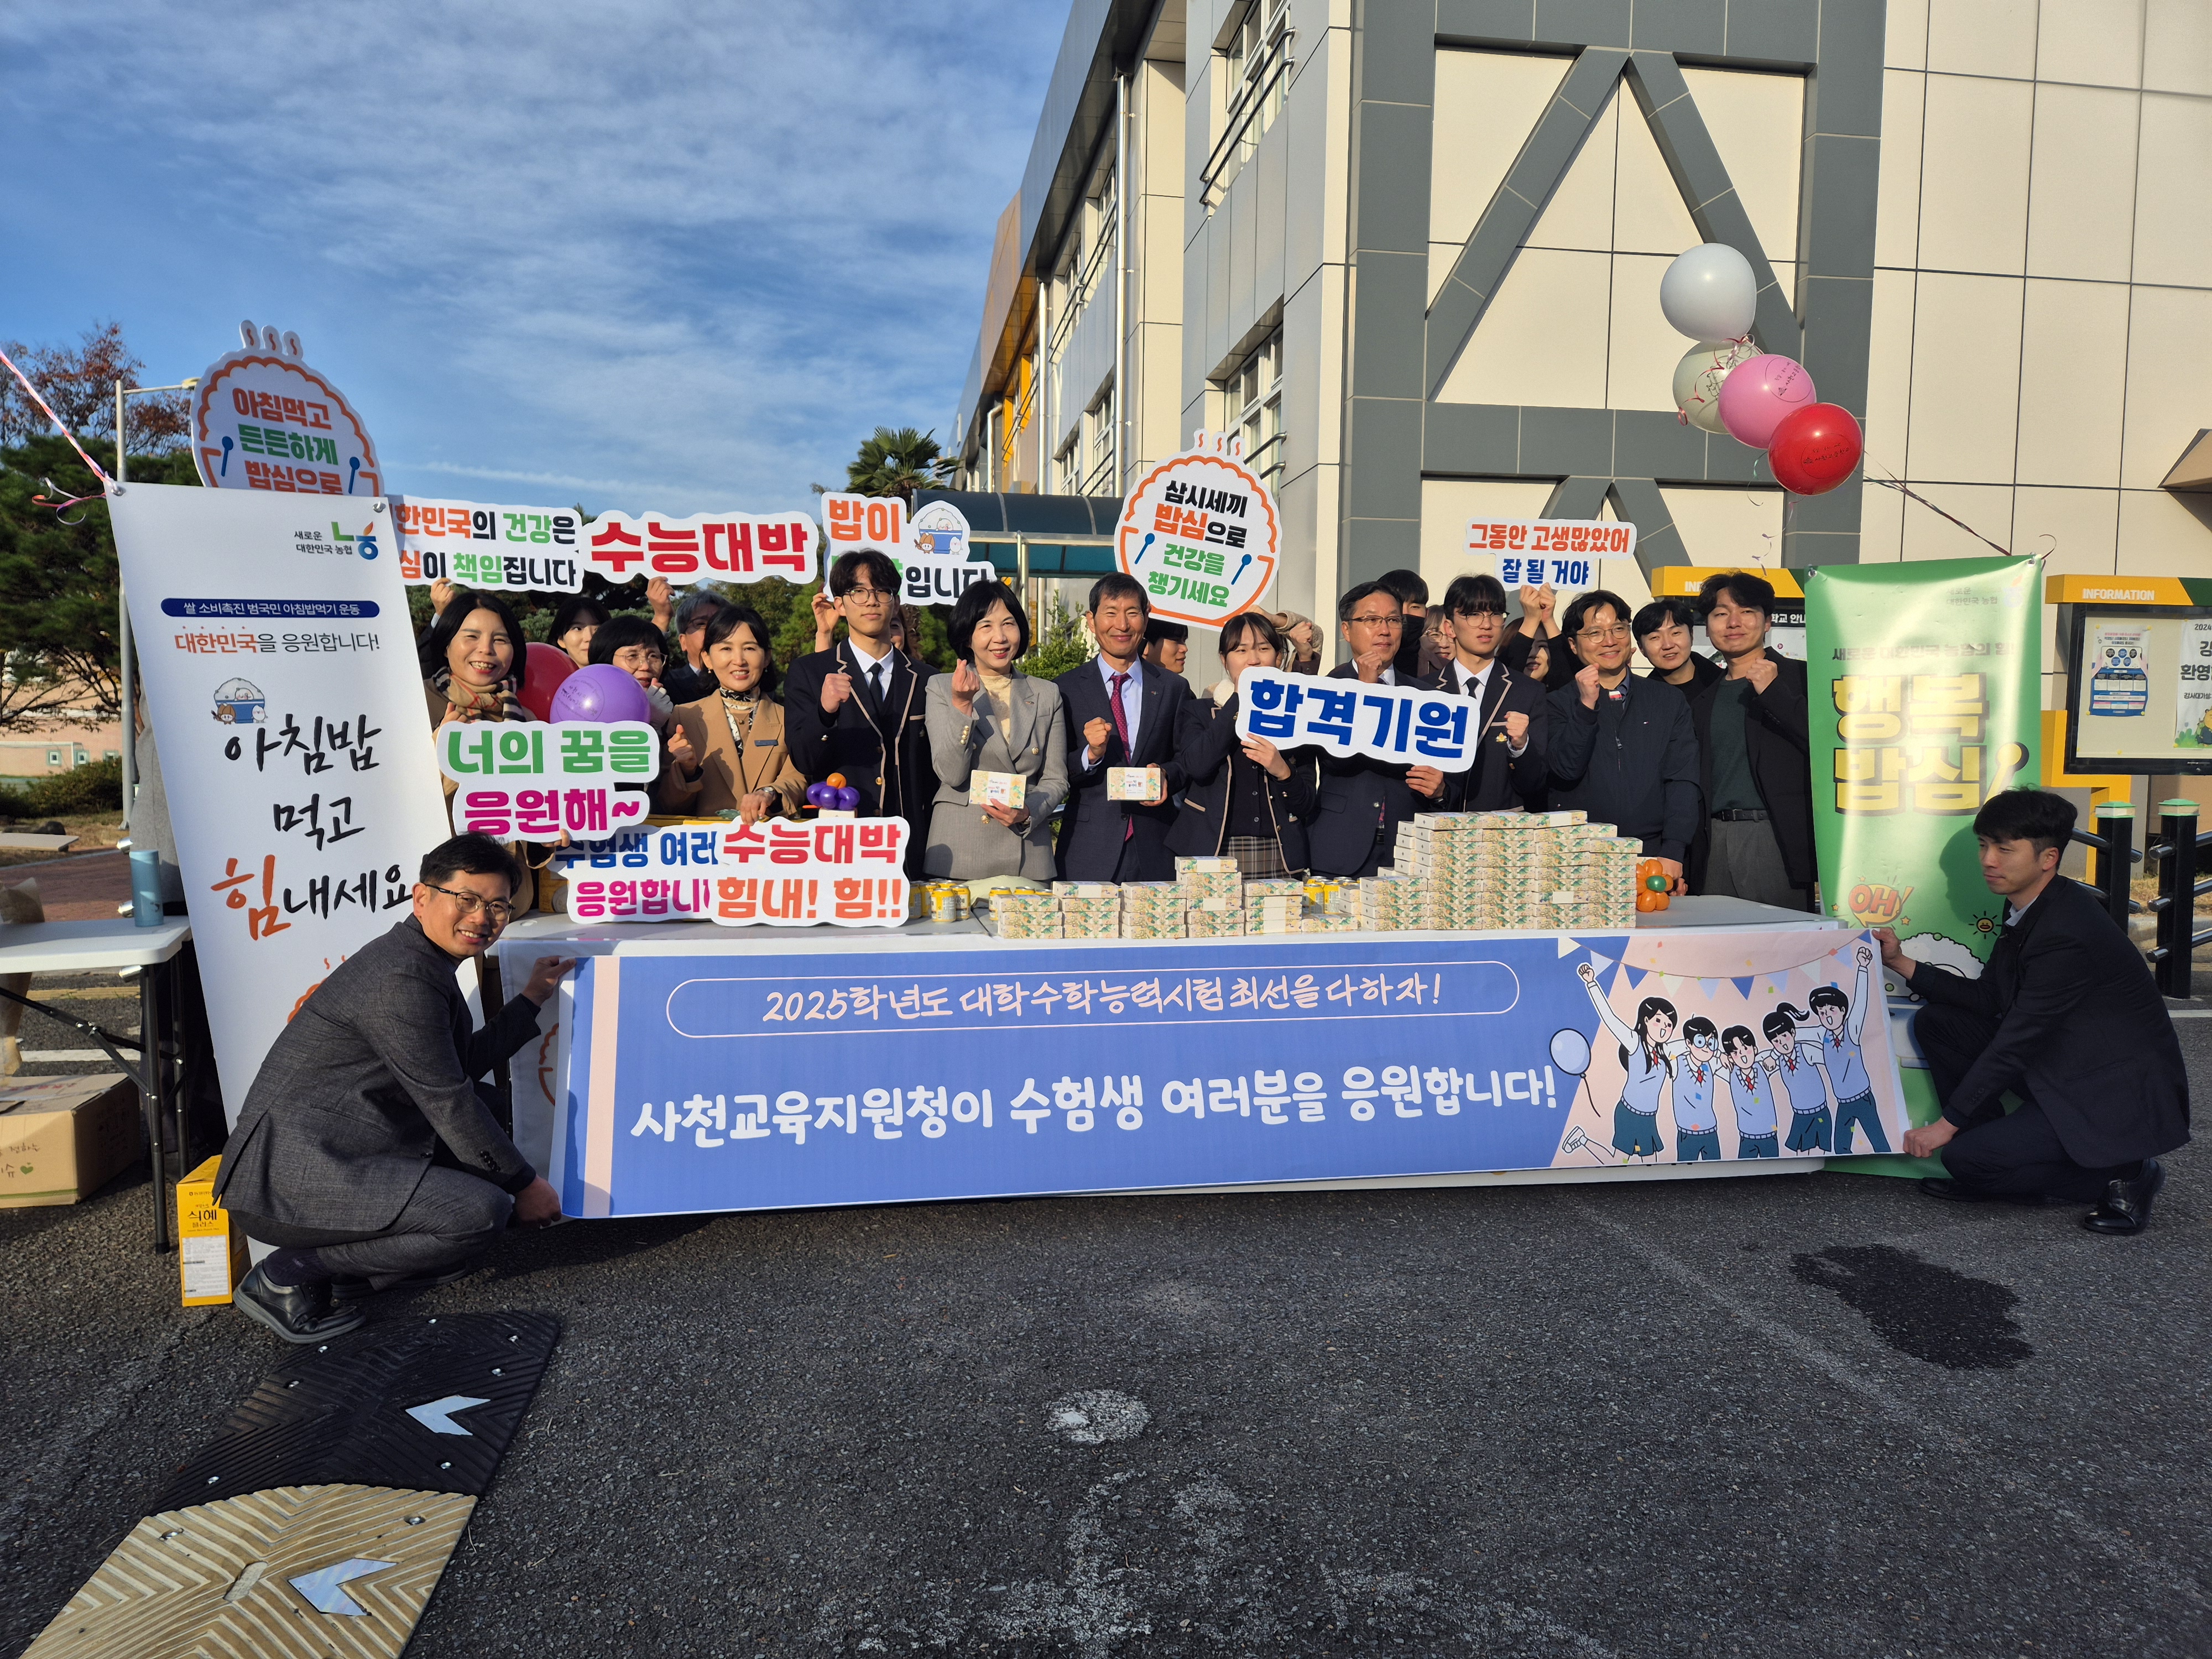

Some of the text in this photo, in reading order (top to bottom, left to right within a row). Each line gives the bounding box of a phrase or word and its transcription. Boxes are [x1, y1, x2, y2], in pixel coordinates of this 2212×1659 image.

[232, 388, 332, 430] 아침먹고
[238, 424, 338, 465] 든든하게
[244, 460, 343, 495] 밥심으로
[1164, 480, 1248, 518] 삼시세끼
[294, 531, 322, 541] 새로운
[389, 503, 575, 544] 한민국의 건강은
[829, 499, 900, 543] 밥이
[1154, 503, 1248, 549] 밥심으로
[1469, 524, 1630, 553] 그동안 고생많았어
[296, 544, 352, 555] 대한민국 농협
[591, 521, 808, 572] 수능대박
[1163, 542, 1225, 576] 건강을
[453, 552, 576, 587] 책임집니다
[1503, 559, 1589, 586] 잘 될 거야
[199, 602, 246, 615] 소비촉진
[247, 603, 281, 615] 범국민
[283, 603, 337, 616] 아침밥먹기
[339, 604, 360, 616] 운동
[1148, 571, 1229, 608] 챙기세요
[1947, 596, 1998, 606] 대한민국 농협
[2083, 588, 2154, 601] INFORMATION
[174, 632, 380, 654] 대한민국을 응원합니다!
[1832, 648, 1875, 660] 새로운
[2180, 664, 2212, 680] 환영
[1248, 679, 1469, 758] 합격기원
[1832, 673, 1987, 743] 행복
[225, 713, 382, 775] 아침밥
[447, 730, 651, 774] 너의 꿈을
[1834, 745, 1986, 815] 밥심
[273, 793, 366, 851] 먹고
[464, 789, 640, 835] 응원해~
[555, 833, 648, 869] 수험생
[723, 823, 901, 864] 수능대박
[576, 879, 710, 917] 응원합니
[717, 877, 817, 919] 힘내!
[833, 878, 901, 919] 힘!!
[763, 972, 1441, 1022] 2025학년도 대학수학능력시험 최선을 다하자!
[630, 1065, 1557, 1148] 사천교육지원청이 수험생 여러분을 응원합니다!
